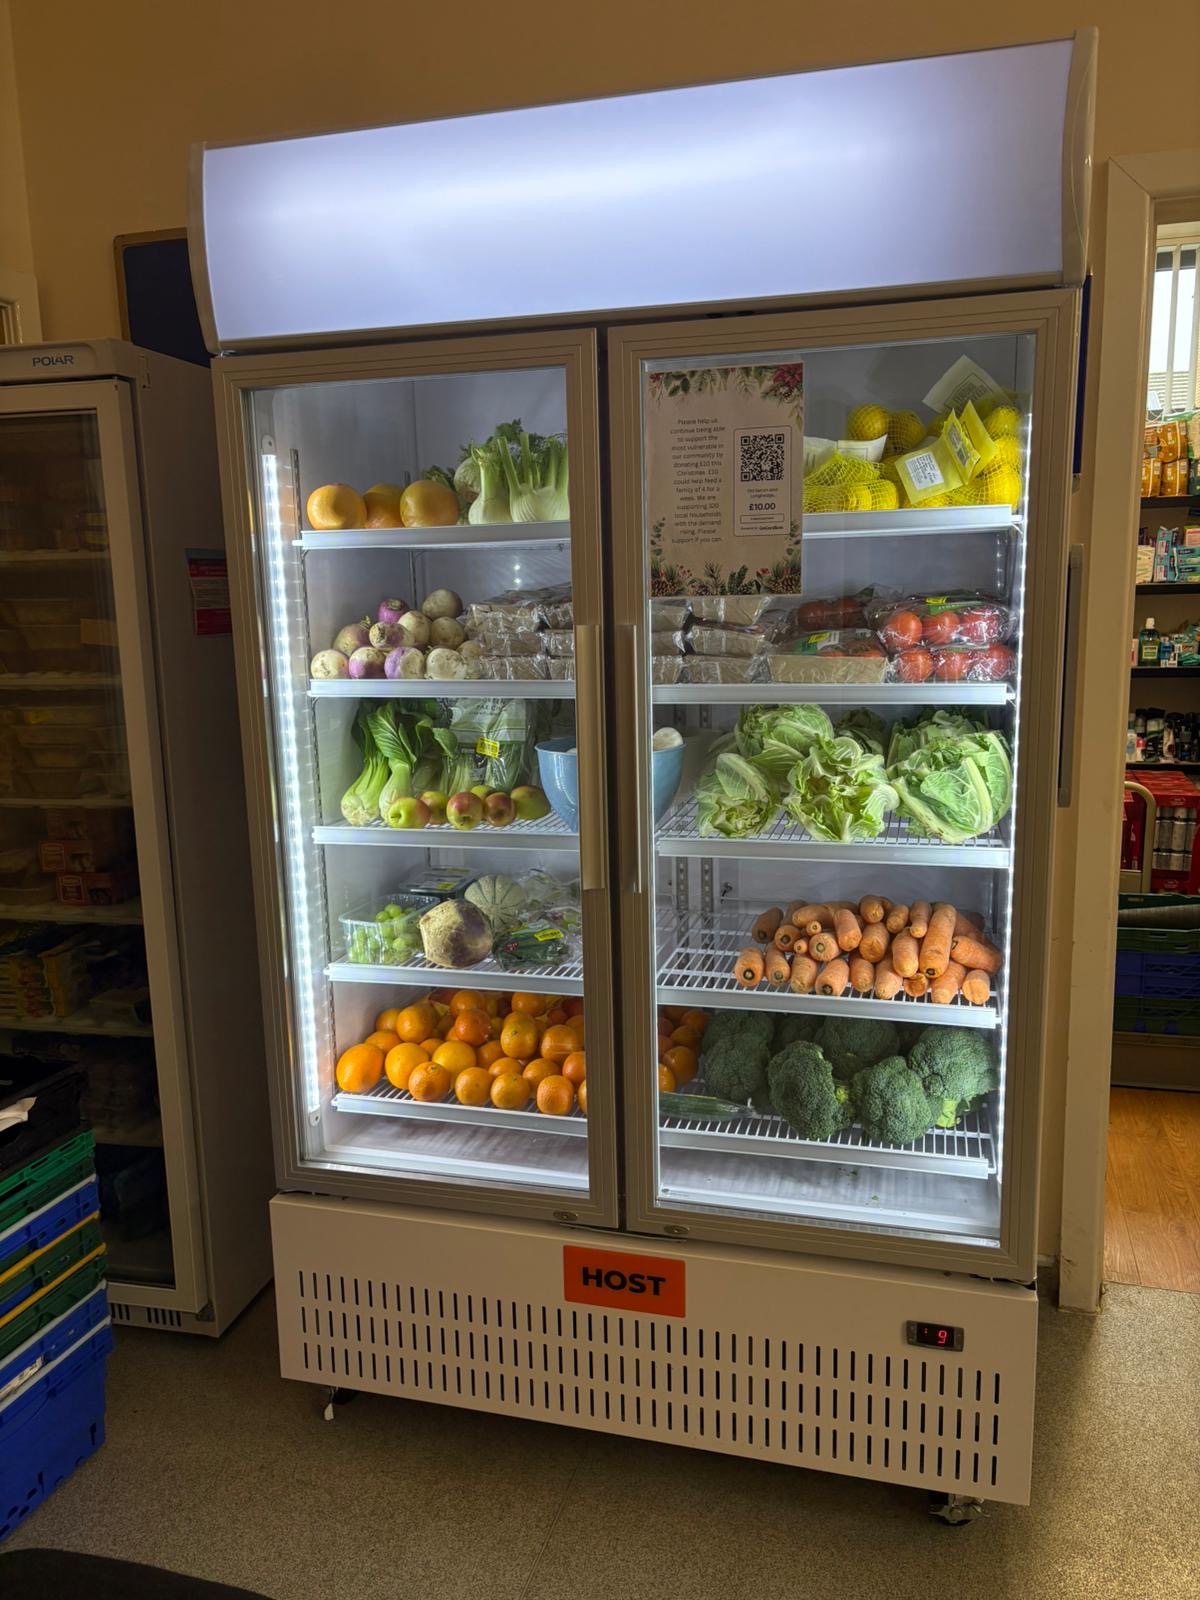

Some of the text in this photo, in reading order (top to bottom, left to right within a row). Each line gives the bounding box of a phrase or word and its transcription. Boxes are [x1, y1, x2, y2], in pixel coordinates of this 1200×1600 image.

[32, 355, 74, 367] POLAR
[673, 461, 698, 469] donating
[676, 503, 707, 511] supporting
[749, 502, 776, 511] £10.00
[672, 537, 694, 545] support
[700, 537, 711, 545] you
[582, 1266, 666, 1296] HOST
[938, 1330, 947, 1344] 9
